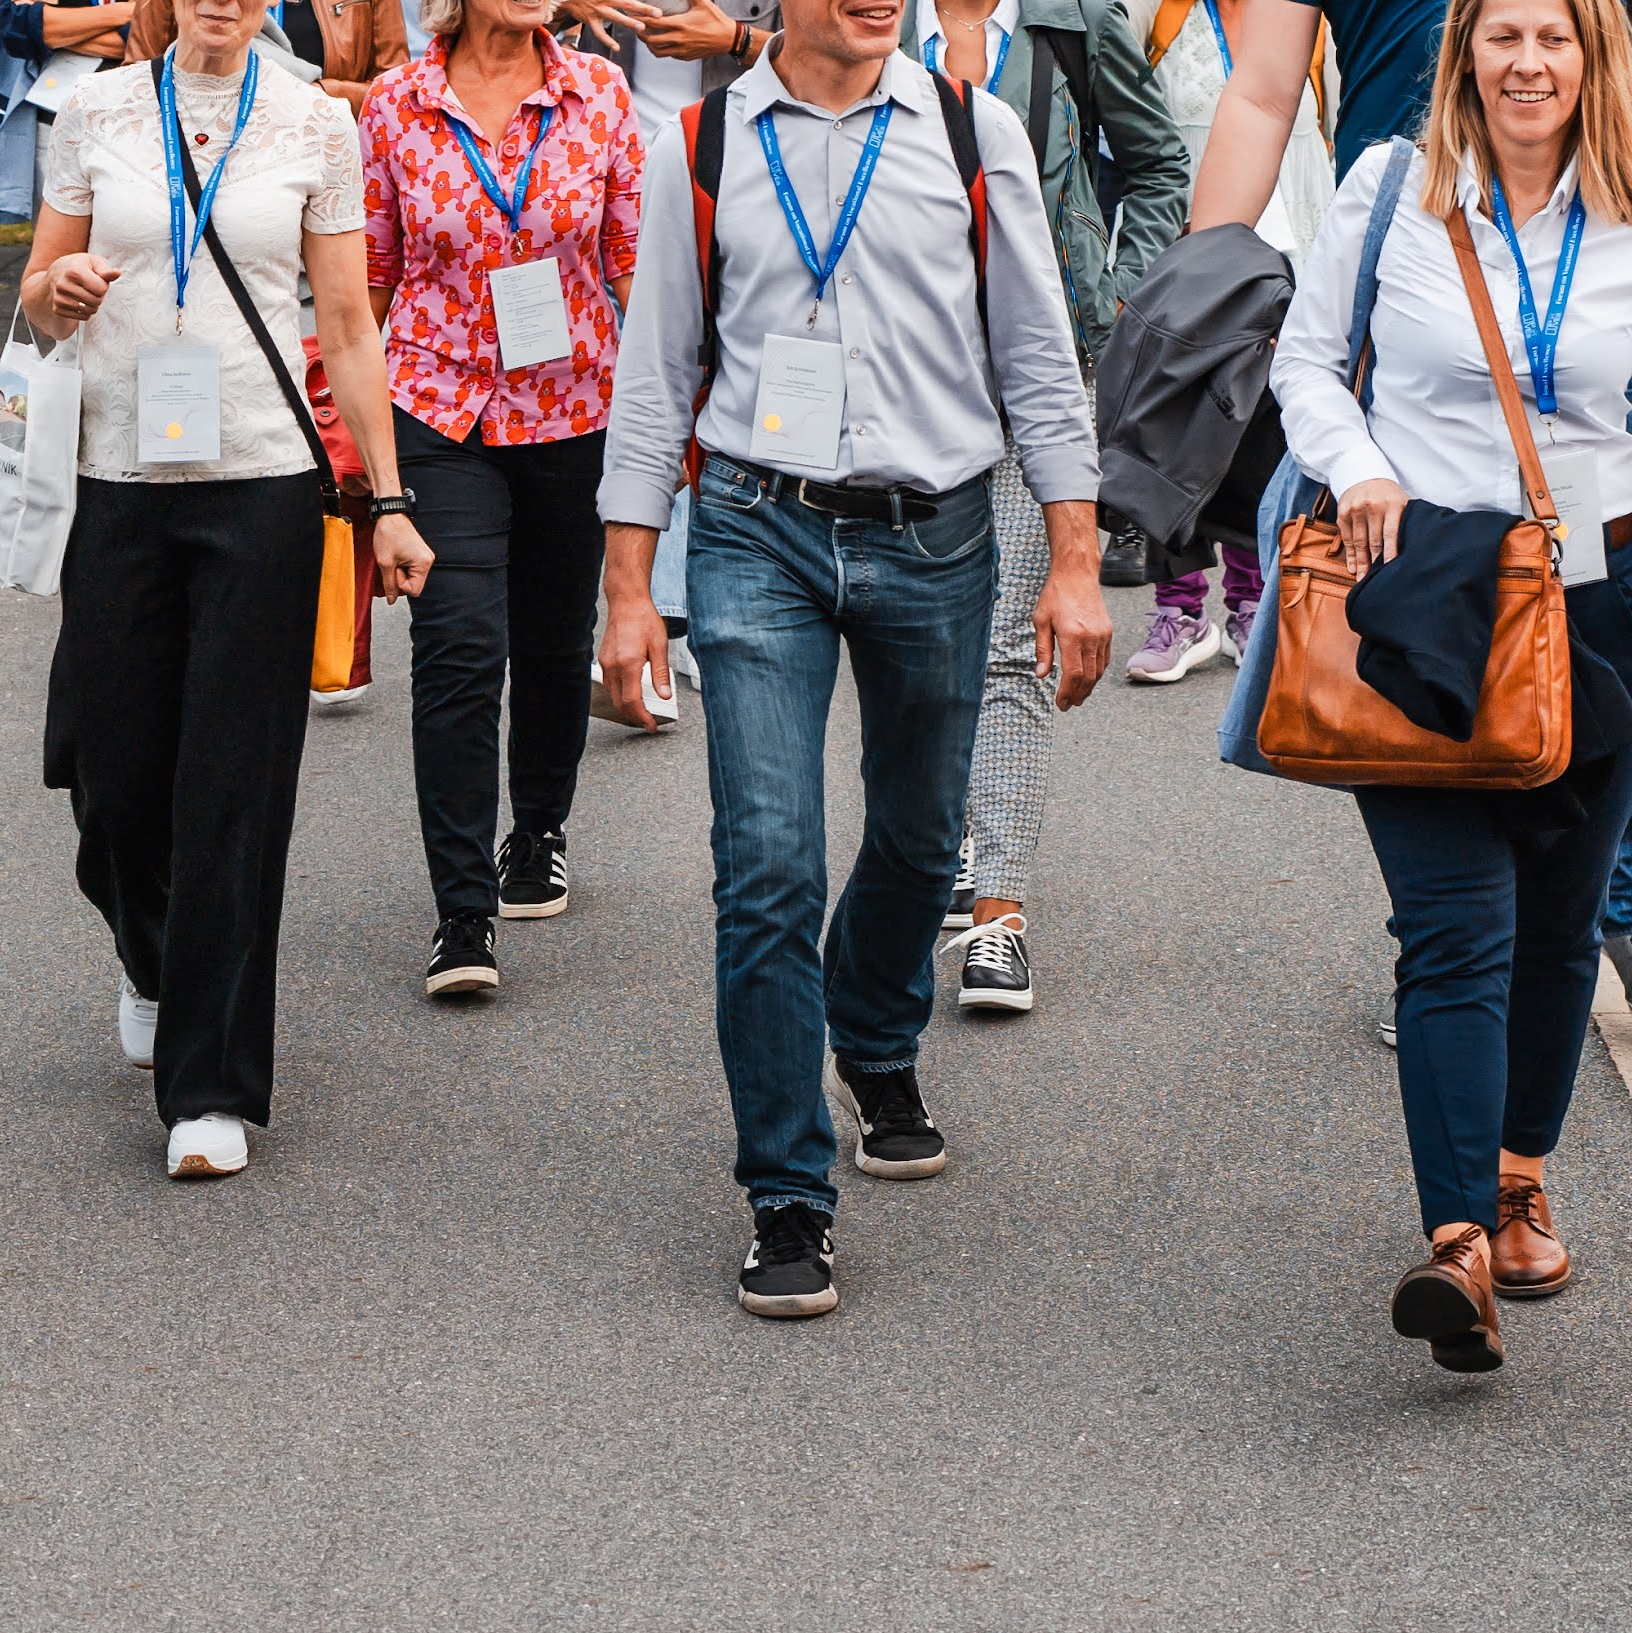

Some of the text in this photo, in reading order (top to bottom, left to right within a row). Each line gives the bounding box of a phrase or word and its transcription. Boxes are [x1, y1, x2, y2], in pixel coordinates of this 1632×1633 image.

[783, 192, 794, 211] Forum
[795, 219, 810, 251] Vocational
[837, 226, 848, 246] Forum
[846, 185, 862, 216] Vocational
